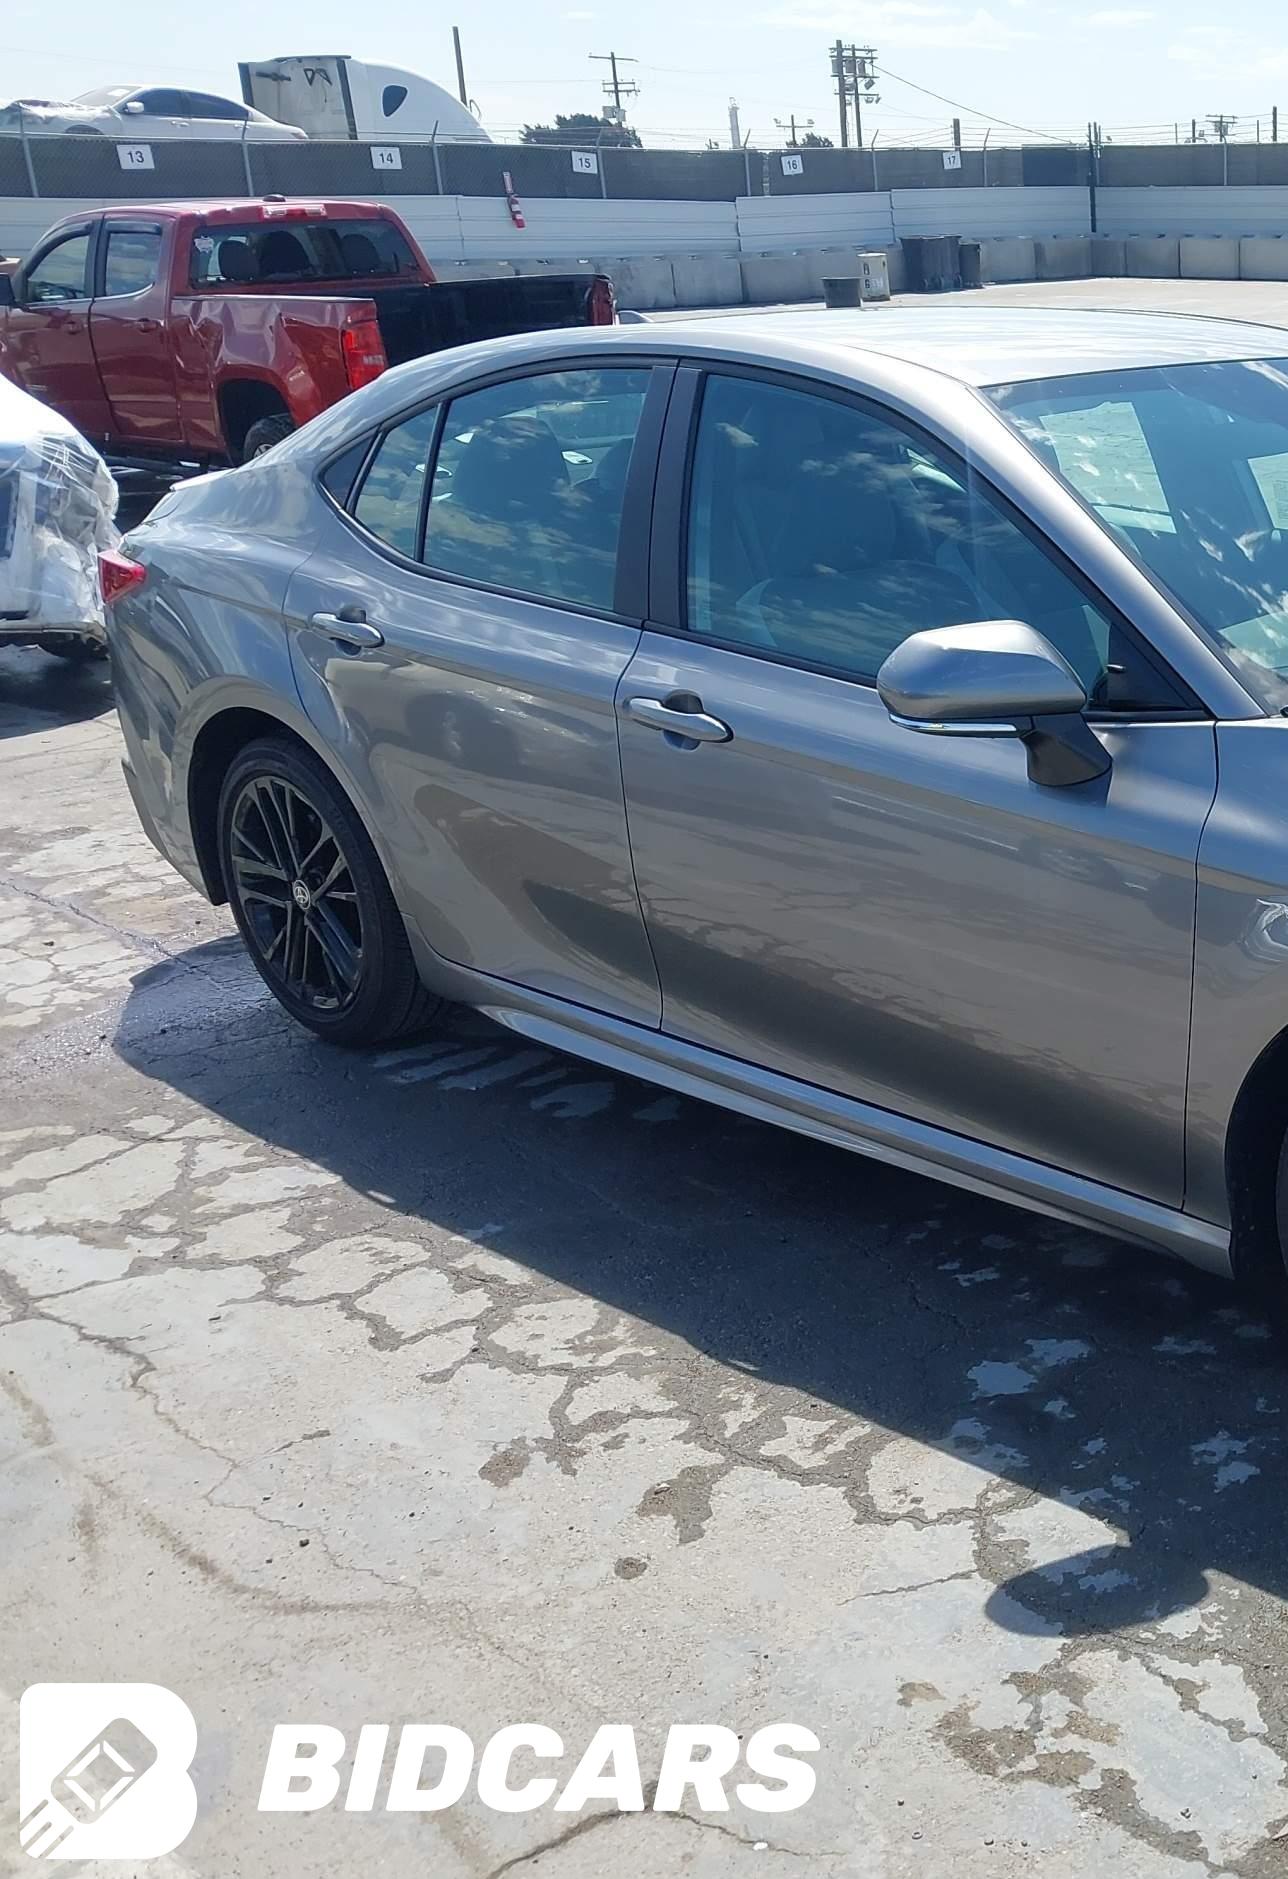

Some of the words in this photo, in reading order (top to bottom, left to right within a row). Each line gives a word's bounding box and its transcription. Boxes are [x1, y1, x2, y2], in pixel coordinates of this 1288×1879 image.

[127, 150, 145, 163] 13
[379, 152, 394, 164] 14
[947, 155, 956, 165] 17
[578, 157, 592, 169] 15
[787, 159, 798, 171] 16
